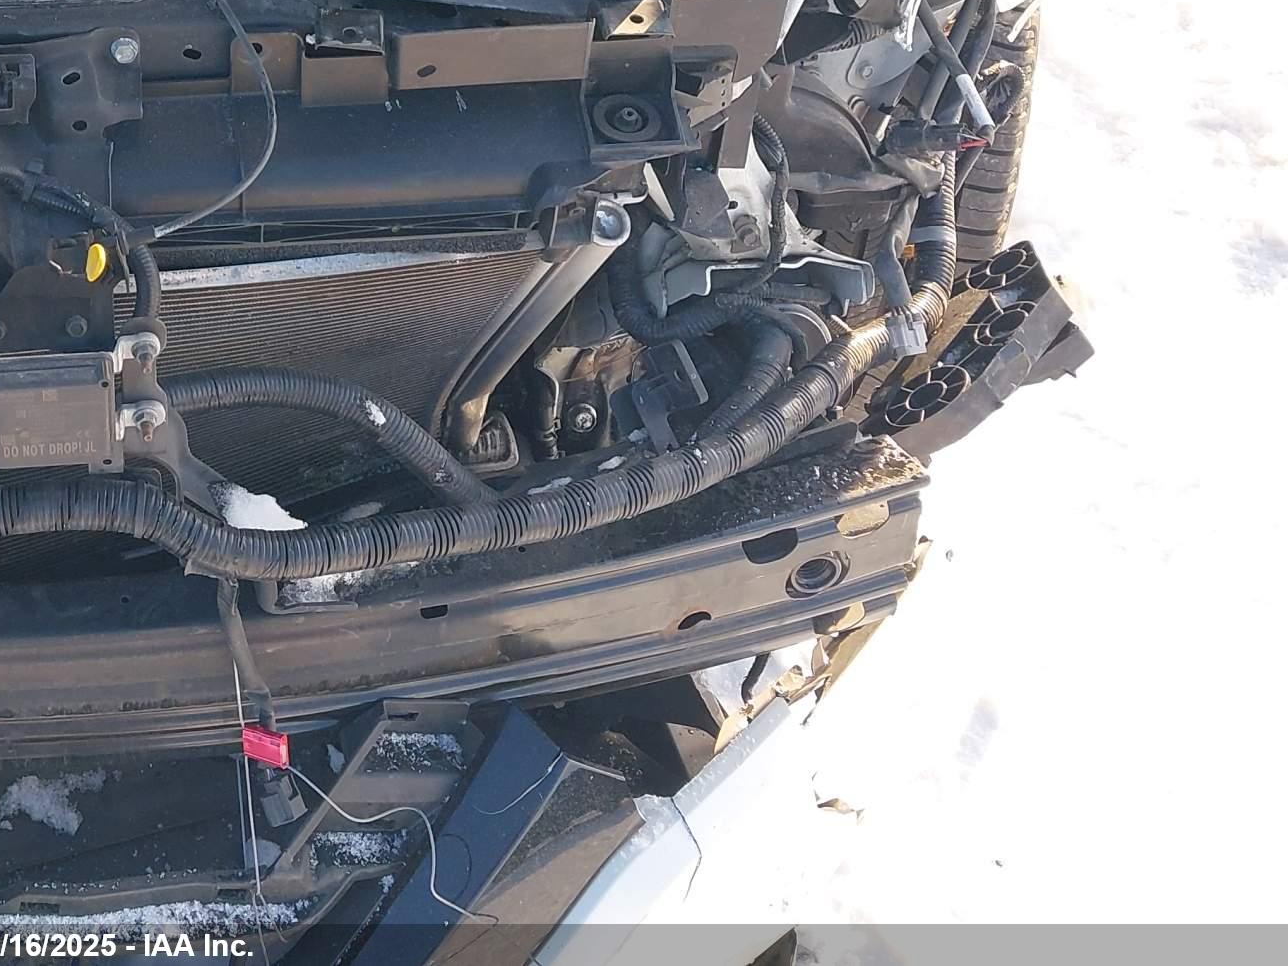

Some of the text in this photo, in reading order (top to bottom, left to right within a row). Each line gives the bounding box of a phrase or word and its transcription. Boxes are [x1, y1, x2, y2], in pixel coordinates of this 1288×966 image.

[3, 446, 19, 458] DO
[22, 444, 46, 457] NOT
[48, 441, 82, 455] DROP!
